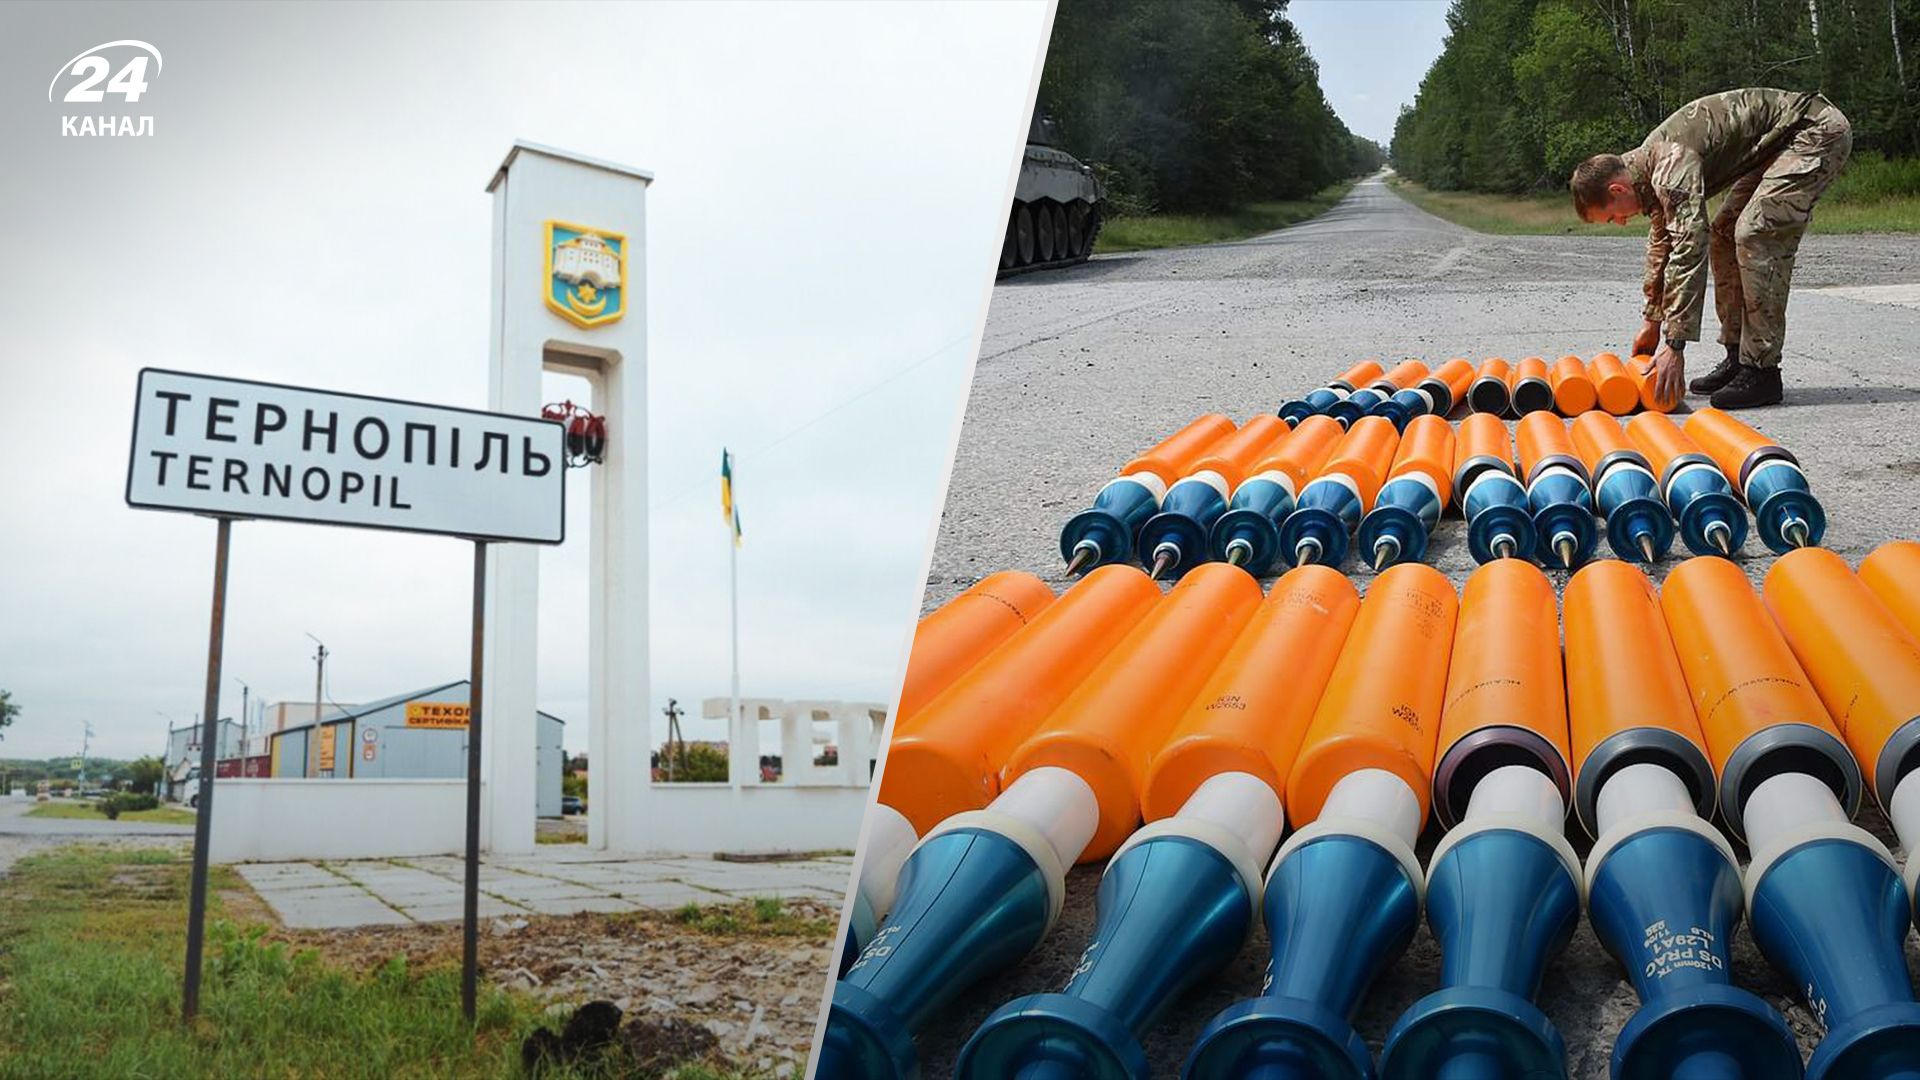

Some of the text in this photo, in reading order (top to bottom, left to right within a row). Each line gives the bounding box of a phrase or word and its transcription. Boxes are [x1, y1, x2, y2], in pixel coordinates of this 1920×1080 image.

[155, 390, 551, 478] ТЕРНОПІЛЬ
[149, 450, 412, 510] TERNOPIL
[1646, 949, 1722, 977] DS PRAC
[1654, 935, 1709, 954] L29A1
